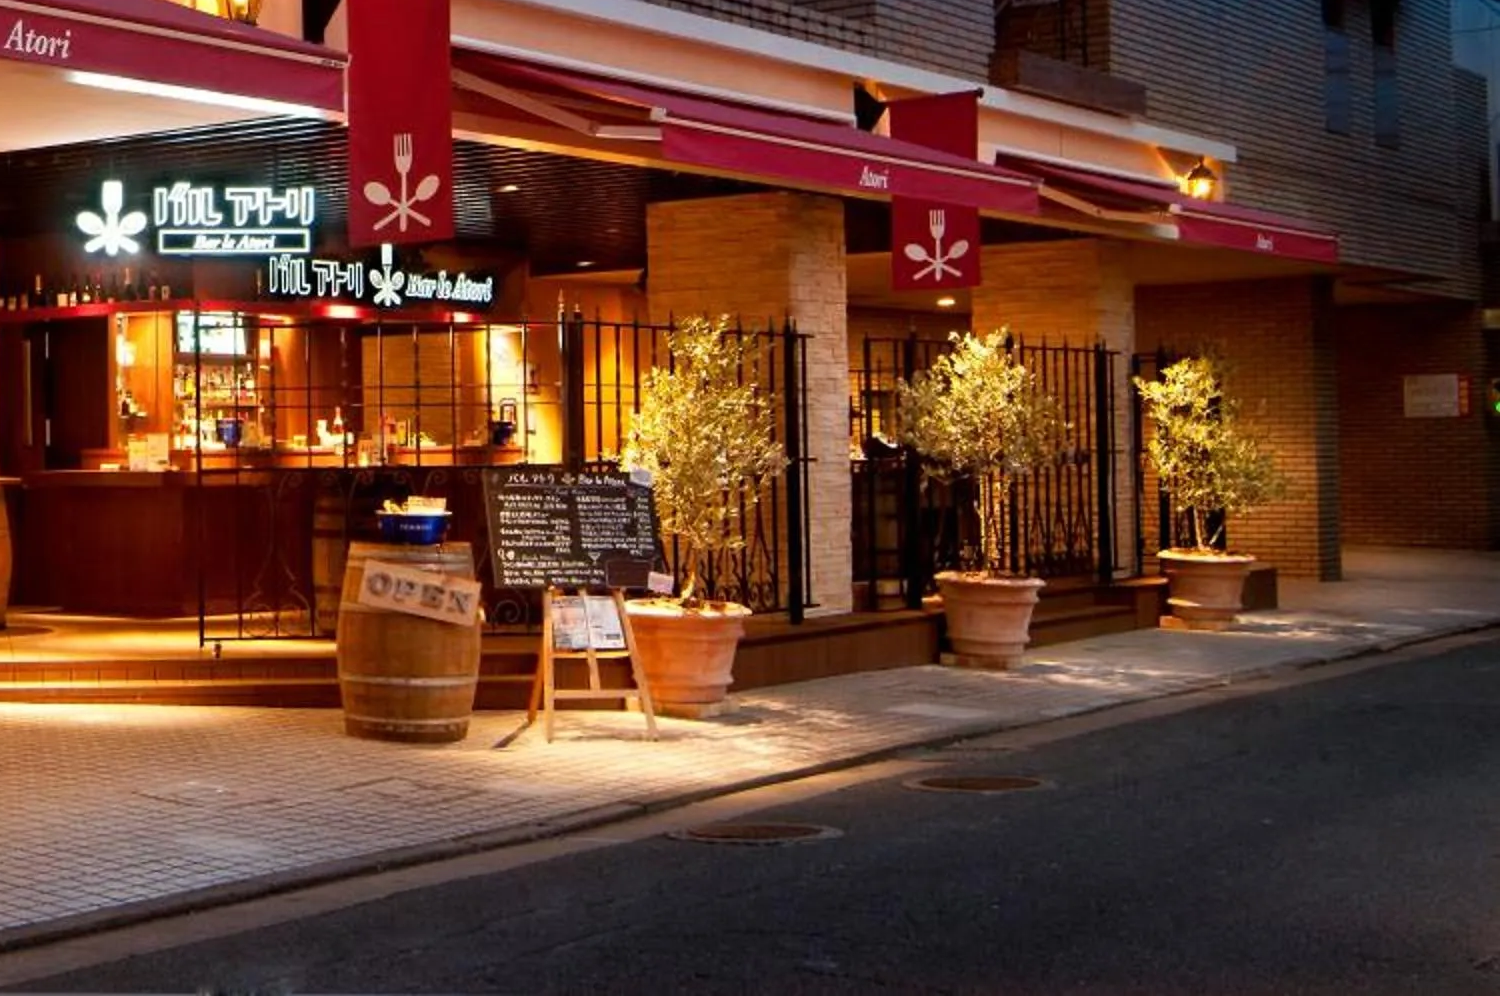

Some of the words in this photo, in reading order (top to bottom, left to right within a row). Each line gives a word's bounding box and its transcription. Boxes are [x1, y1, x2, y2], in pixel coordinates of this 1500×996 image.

[3, 19, 72, 59] Atori
[859, 165, 889, 189] Atori
[225, 187, 315, 226] アトリ
[312, 260, 364, 298] アトリ
[405, 273, 436, 298] Bar
[366, 572, 472, 613] OPEN
